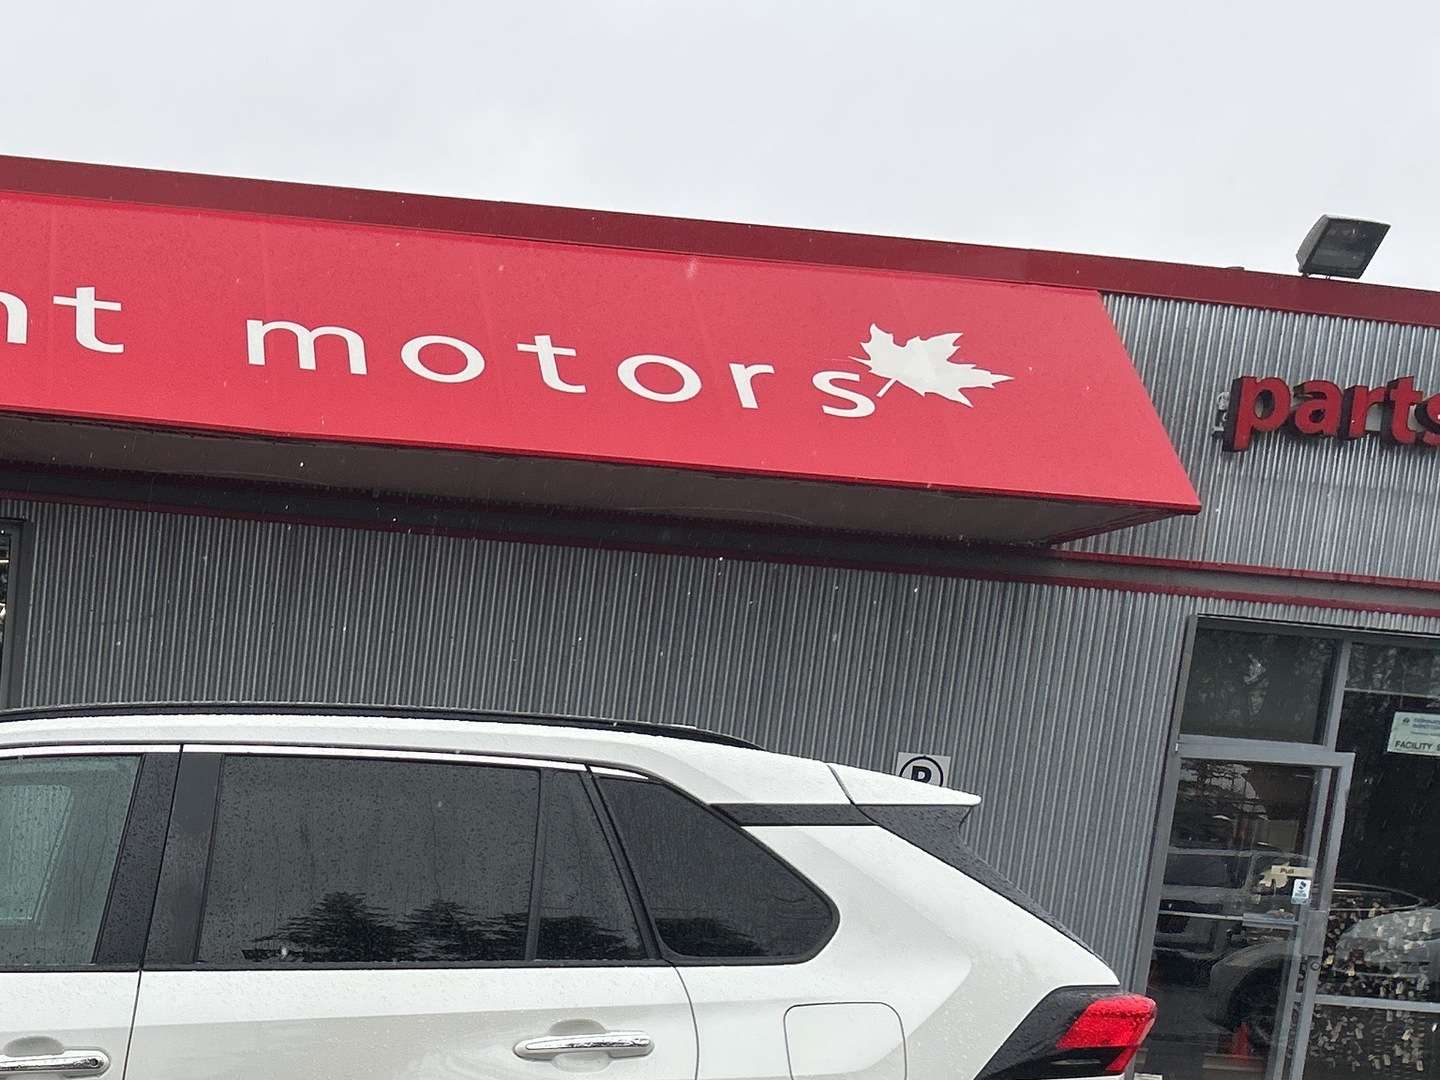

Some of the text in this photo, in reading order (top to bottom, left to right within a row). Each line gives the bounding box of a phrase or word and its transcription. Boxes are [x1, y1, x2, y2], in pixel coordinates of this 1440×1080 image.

[246, 318, 878, 418] motors
[1223, 376, 1440, 452] parts
[1394, 740, 1433, 750] FACILITY
